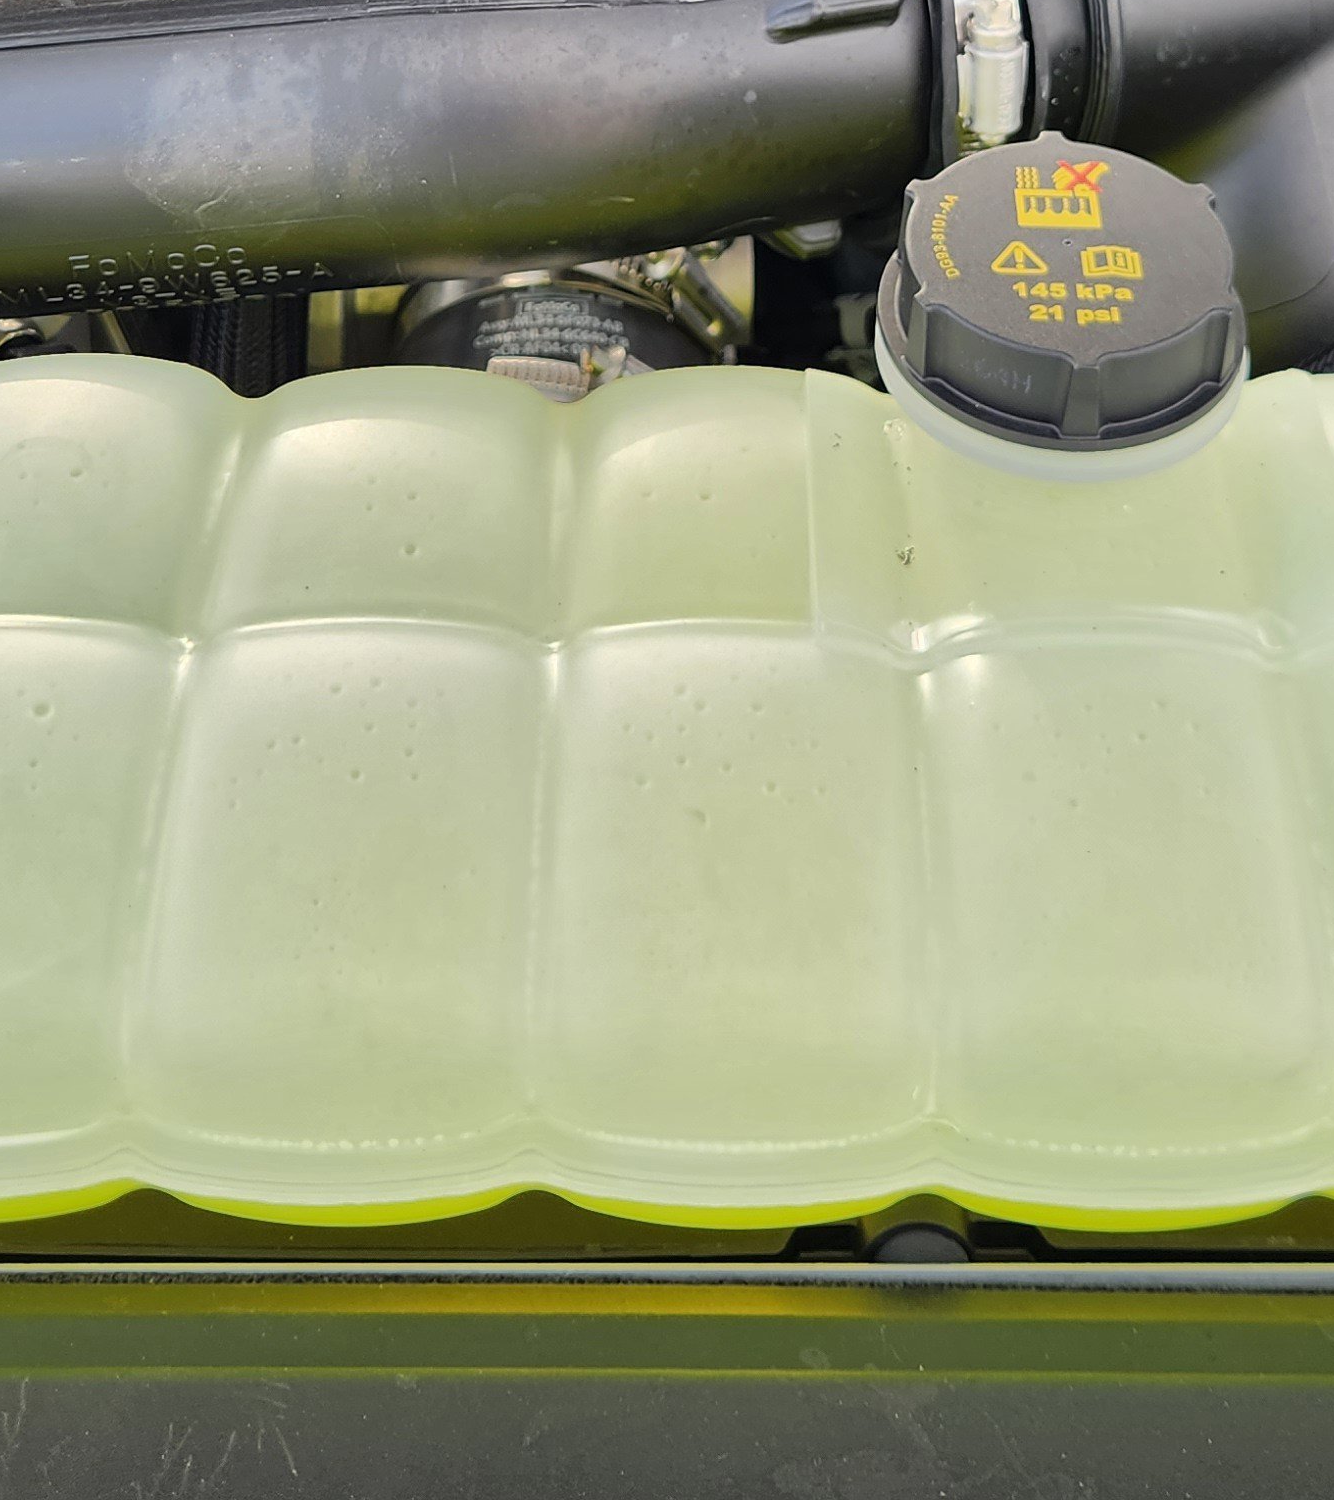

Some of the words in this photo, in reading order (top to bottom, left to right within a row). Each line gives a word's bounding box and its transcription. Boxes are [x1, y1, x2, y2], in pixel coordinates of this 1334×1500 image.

[68, 243, 246, 279] FoMoCo
[1012, 281, 1067, 299] 145
[1075, 283, 1134, 302] kPa
[1028, 303, 1064, 322] 21
[1076, 306, 1121, 327] psi
